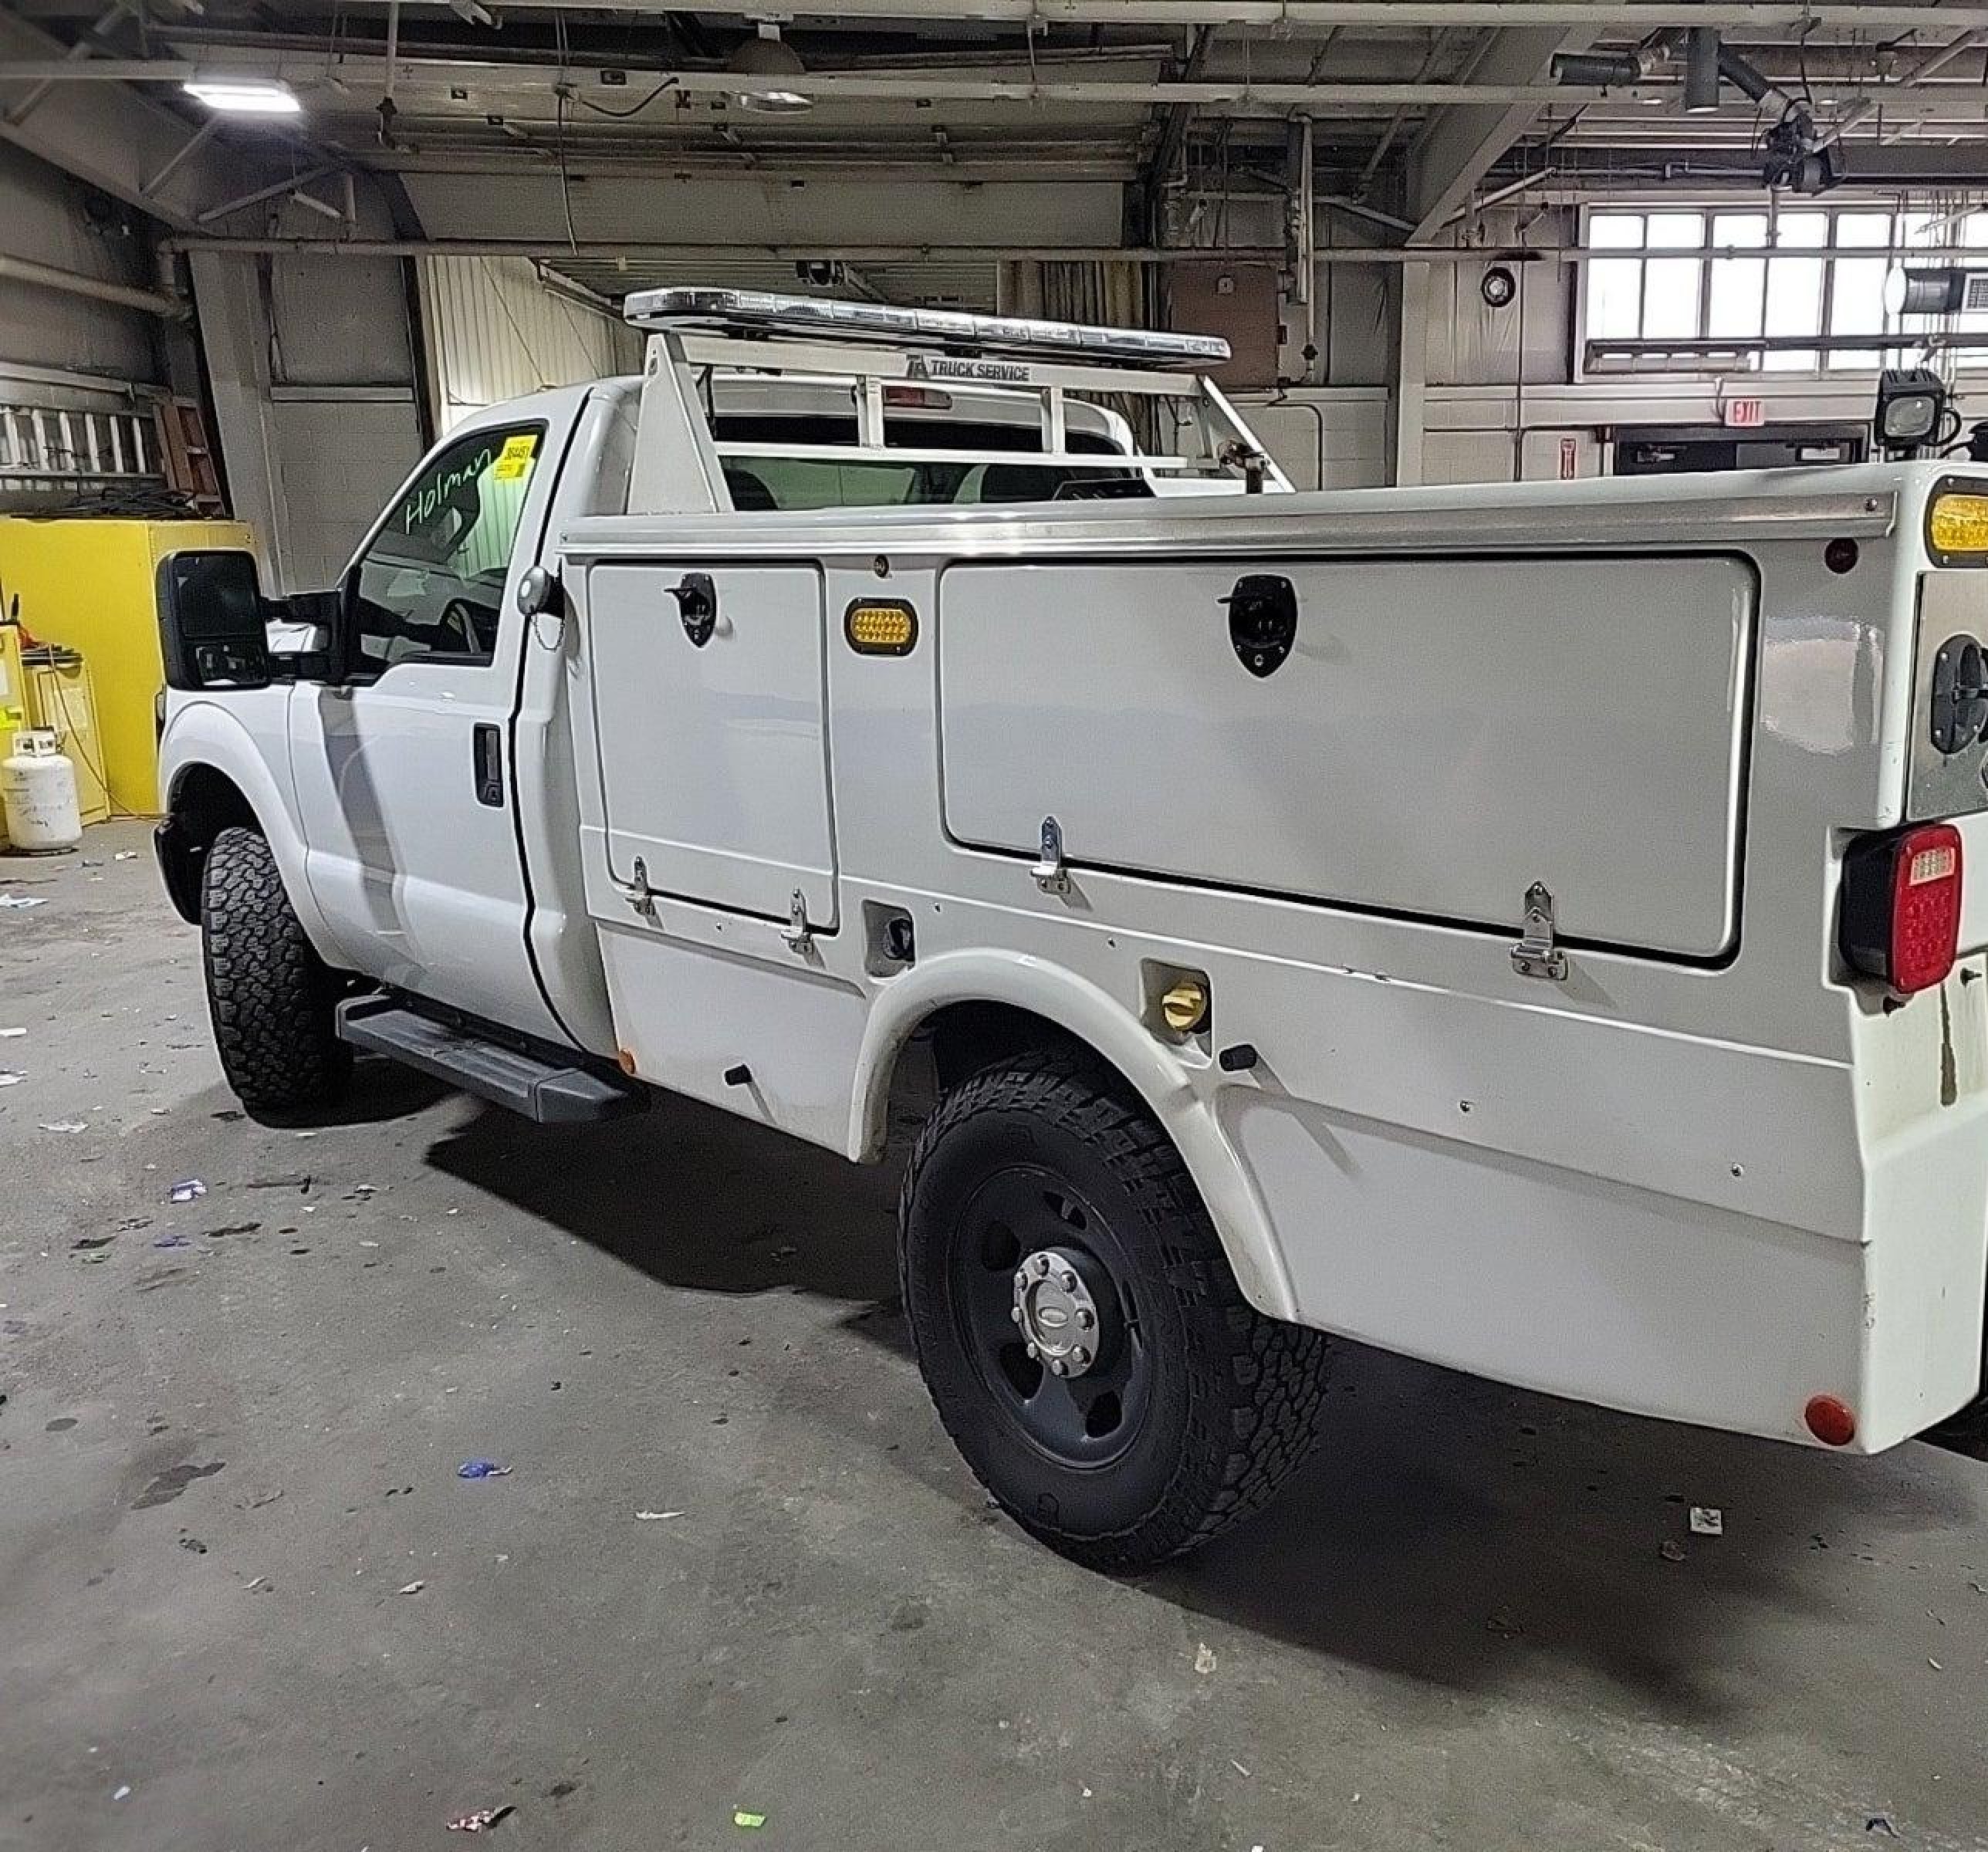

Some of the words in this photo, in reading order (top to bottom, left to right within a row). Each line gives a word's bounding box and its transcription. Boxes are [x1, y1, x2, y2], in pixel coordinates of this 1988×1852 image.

[931, 360, 975, 377] TRUCK
[977, 364, 1030, 381] SERVICE
[1733, 401, 1761, 423] EXIT
[405, 448, 492, 535] Holman
